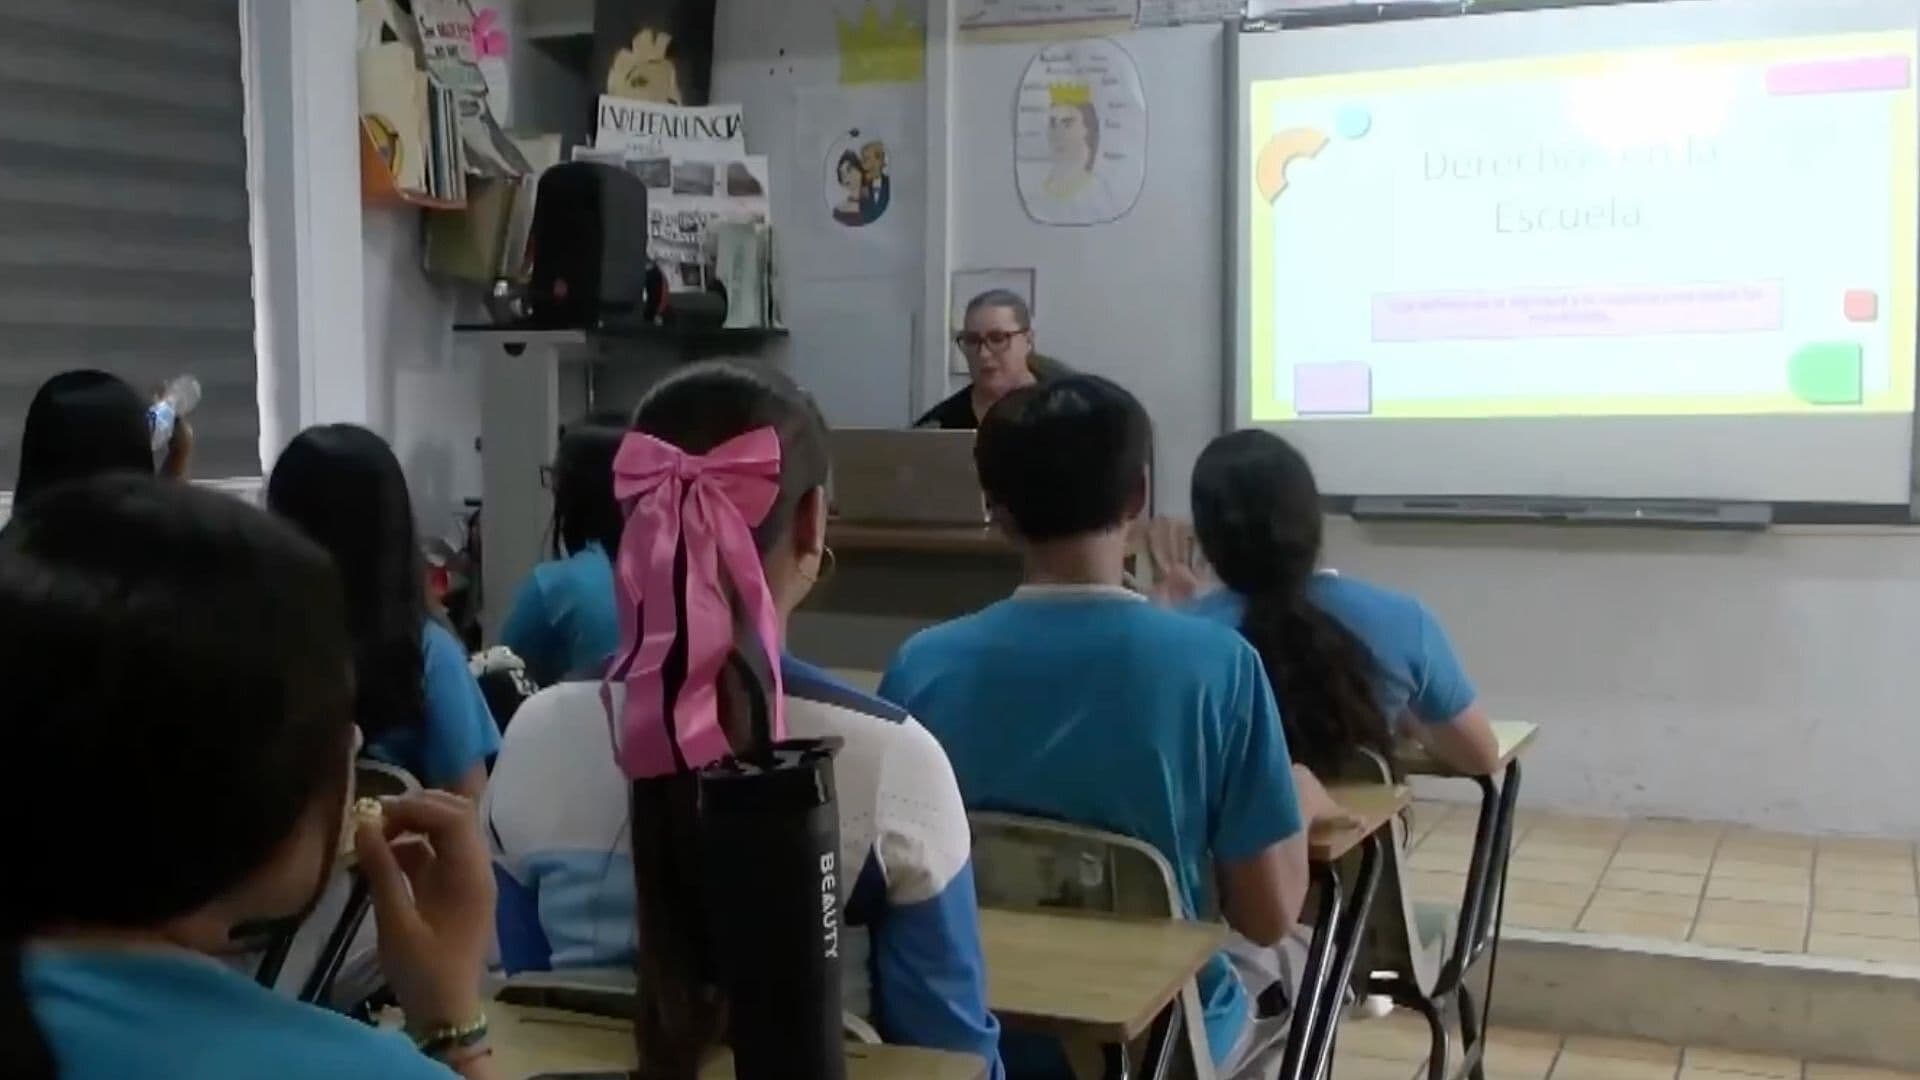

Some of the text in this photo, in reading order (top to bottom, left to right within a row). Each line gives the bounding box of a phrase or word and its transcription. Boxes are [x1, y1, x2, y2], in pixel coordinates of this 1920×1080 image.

[1423, 142, 1603, 181] Derecho
[1495, 195, 1642, 234] Escuela
[819, 851, 839, 958] BEAUTY
